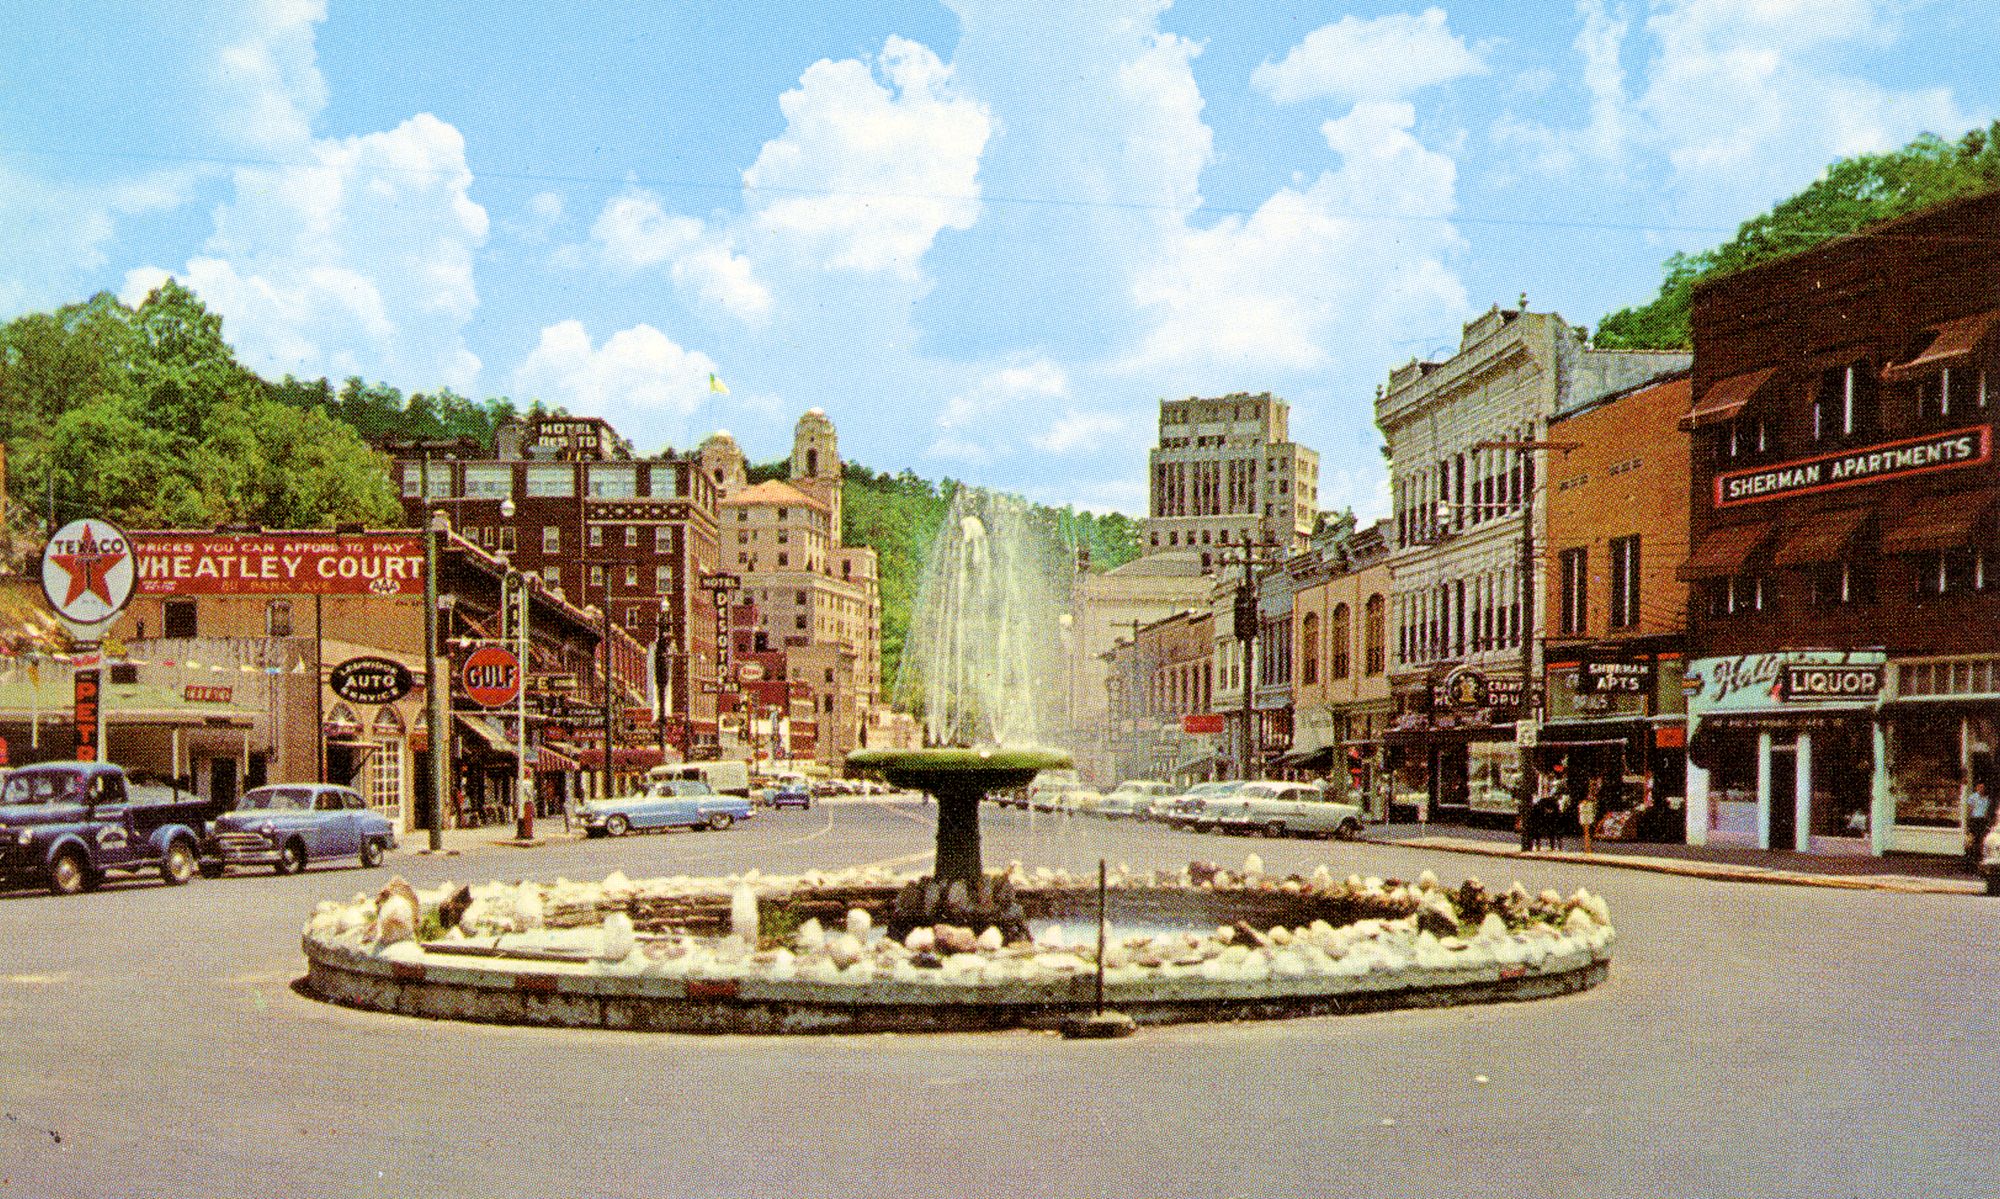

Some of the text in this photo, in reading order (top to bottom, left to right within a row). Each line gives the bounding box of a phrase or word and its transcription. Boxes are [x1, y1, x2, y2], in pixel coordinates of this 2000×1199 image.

[541, 423, 595, 434] HOTEL
[1729, 437, 1971, 498] SHERMAN APARTMENTS
[54, 538, 124, 555] TEXACO
[202, 543, 234, 553] YOU
[241, 543, 275, 553] CAN
[283, 543, 338, 553] AFFORD
[345, 543, 364, 553] TO
[317, 556, 424, 578] COURT
[250, 581, 292, 592] PARK
[372, 580, 397, 591] AAA
[702, 577, 738, 588] HOTEL
[345, 675, 396, 688] AUTO
[467, 666, 516, 688] GULF
[1596, 676, 1640, 690] APTS
[1790, 672, 1876, 693] LIQUOR
